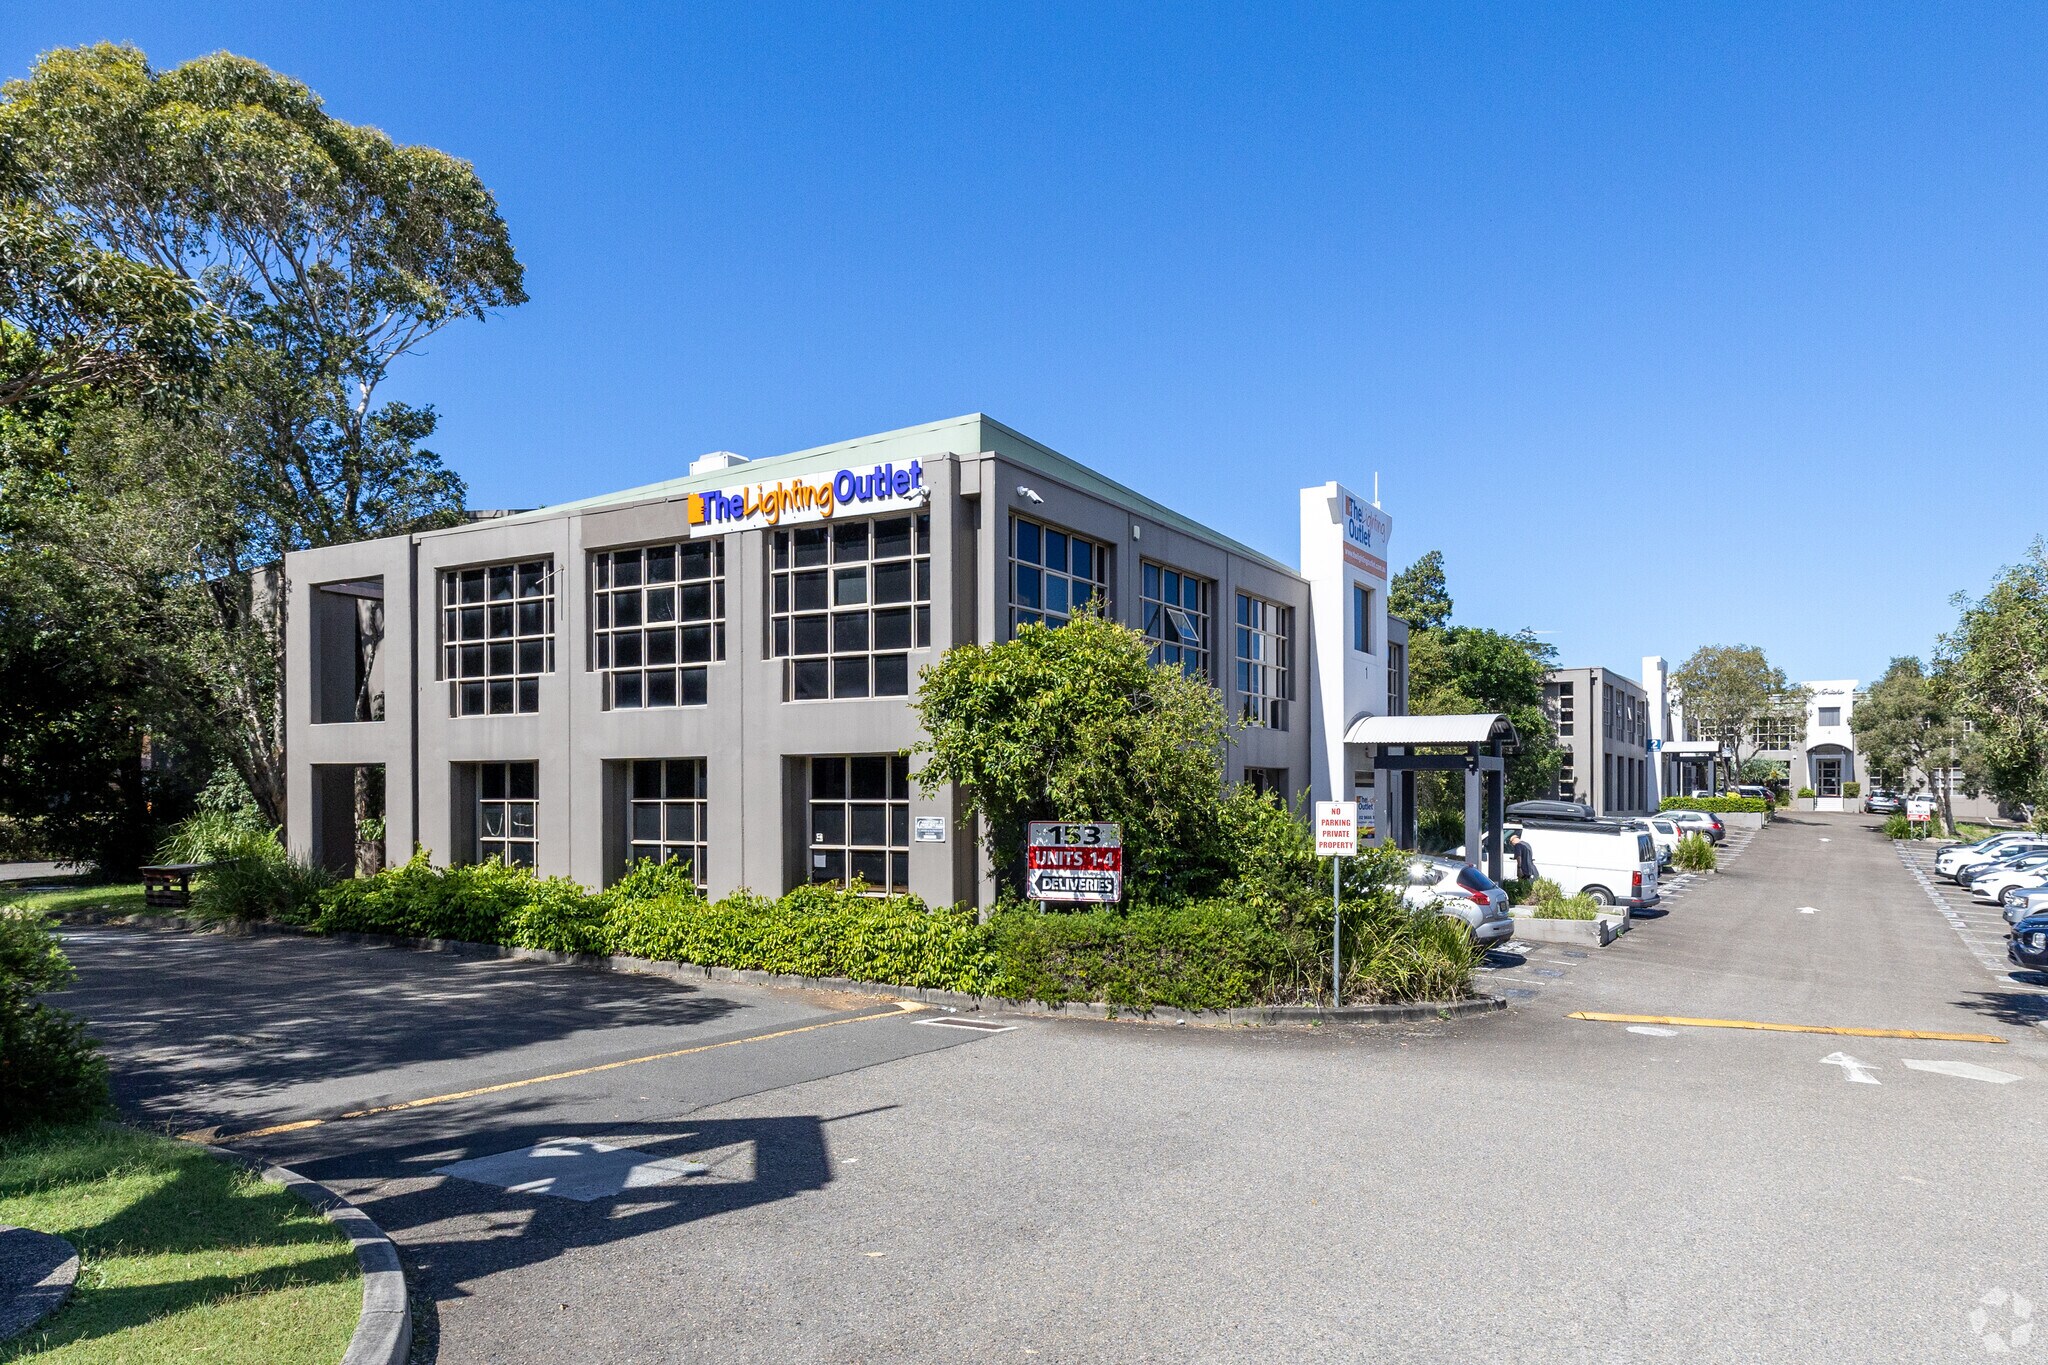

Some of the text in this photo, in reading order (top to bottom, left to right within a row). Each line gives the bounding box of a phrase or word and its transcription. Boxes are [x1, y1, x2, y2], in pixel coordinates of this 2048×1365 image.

[1348, 518, 1371, 548] Outlet
[1651, 739, 1659, 749] 2
[1321, 819, 1351, 827] PARKING
[1048, 825, 1101, 845] 153
[1322, 830, 1350, 838] PRIVATE
[1319, 841, 1354, 849] PROPERTY
[1035, 850, 1114, 867] UNITS 1-4
[1042, 878, 1112, 891] DELIVERIES
